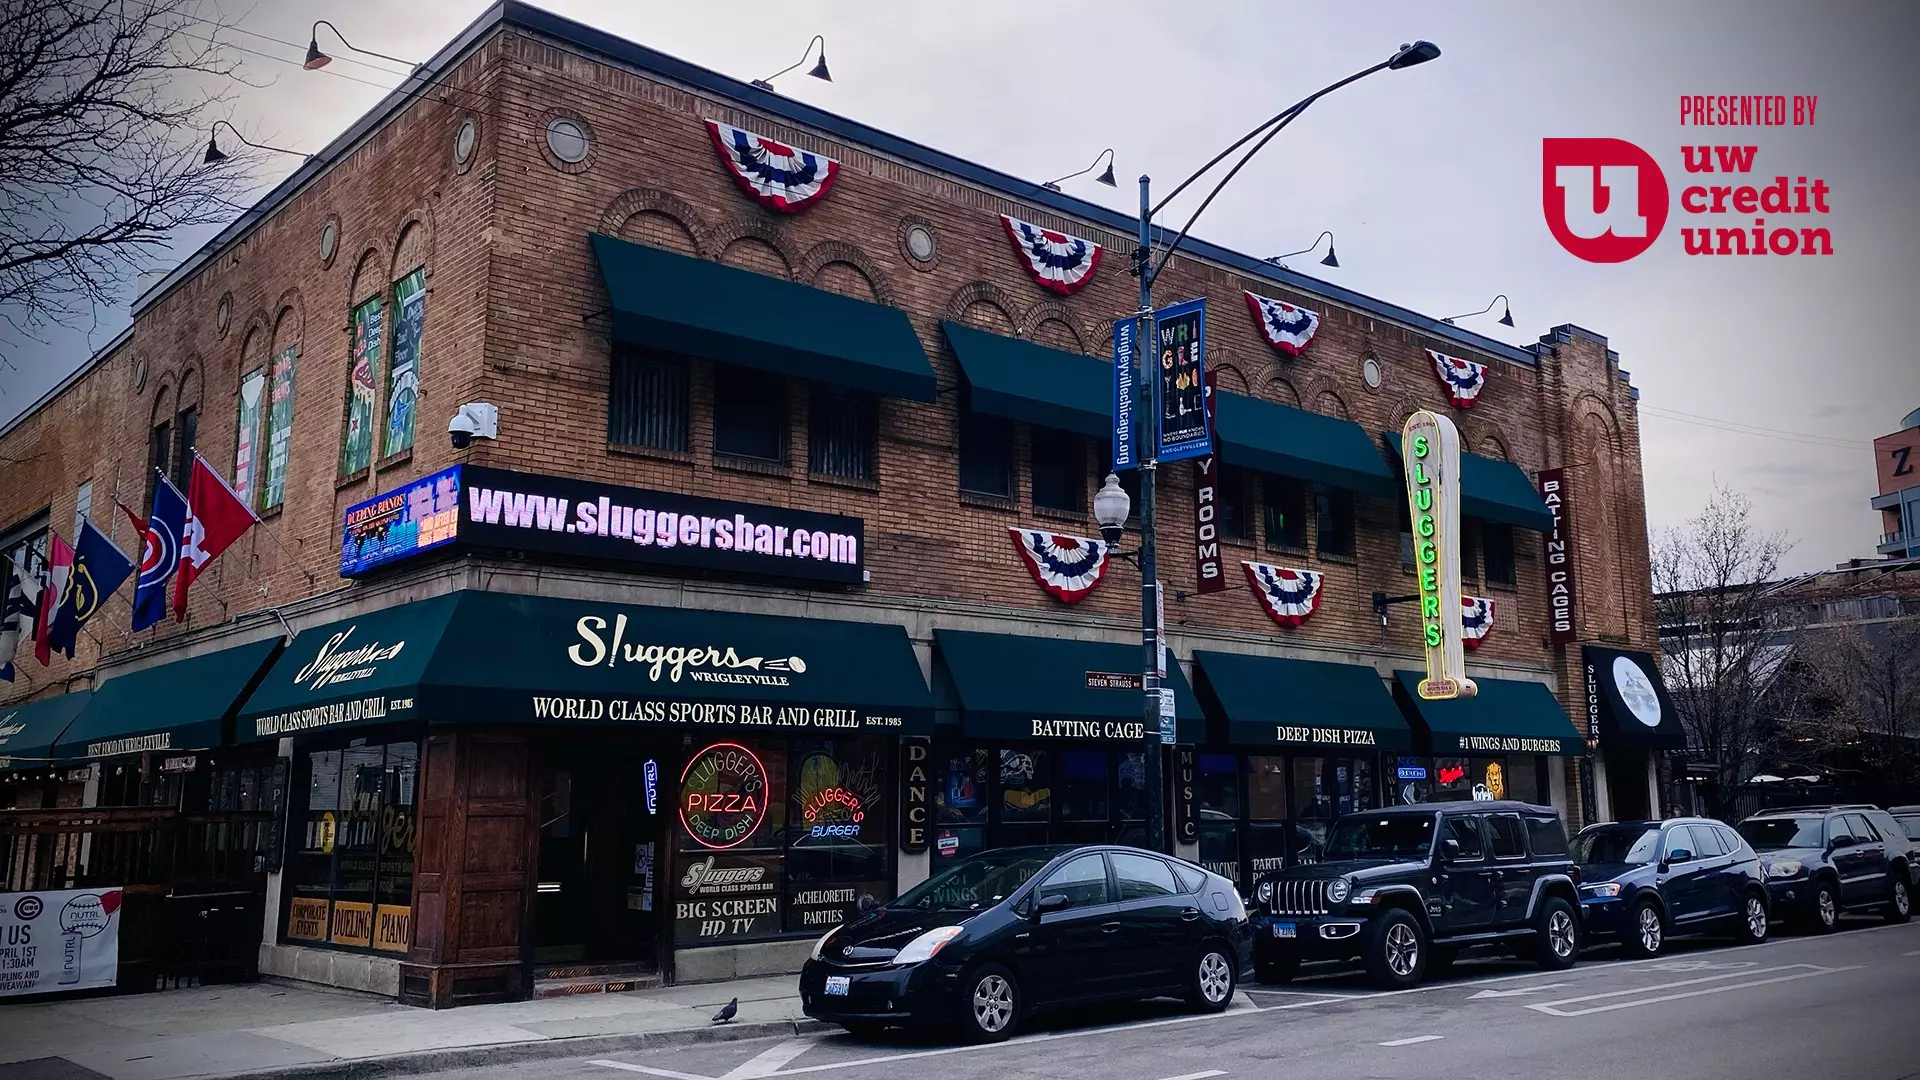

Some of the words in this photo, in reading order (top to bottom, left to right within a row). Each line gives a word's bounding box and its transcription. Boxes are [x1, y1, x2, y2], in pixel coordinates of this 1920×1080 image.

[1116, 324, 1132, 465] wrigleyvillechicago.org
[1892, 446, 1913, 477] Z
[468, 486, 857, 565] www.sluggersbar.com
[1198, 486, 1218, 579] ROOMS
[1543, 480, 1565, 564] BATTING
[1414, 434, 1440, 648] SLUGGERS
[1551, 571, 1571, 632] CAGES
[293, 625, 382, 691] Sluggers
[568, 613, 764, 683] Sluggers
[689, 671, 790, 687] WRIGLEYVILLE
[1088, 678, 1108, 687] STEVEN
[1109, 679, 1132, 688] STRAUSS
[256, 713, 280, 737] WORLD
[280, 711, 300, 733] CLASS
[300, 708, 328, 730] SPORTS
[329, 704, 344, 724] BAR
[344, 700, 361, 721] AND
[362, 696, 386, 719] GRILL
[533, 696, 604, 720] WORLD
[608, 699, 665, 722] CLASS
[668, 702, 736, 724] SPORTS
[740, 705, 773, 725] BAR
[776, 706, 810, 726] AND
[813, 708, 860, 728] GRILL
[866, 716, 884, 726] EST.
[884, 717, 902, 727] 1985
[1031, 719, 1101, 738] BATTING
[1105, 721, 1144, 739] CAGE
[1276, 726, 1310, 742] DEEP
[1312, 728, 1341, 743] DISH
[1343, 729, 1375, 745] PIZZA
[1459, 736, 1469, 749] #1
[1470, 736, 1500, 750] WINGS
[1501, 737, 1519, 751] AND
[1520, 739, 1560, 752] BURGERS
[687, 751, 763, 792] SLUGGER'S
[687, 793, 757, 812] PIZZA
[804, 787, 864, 823] SLUGGER'S
[909, 745, 927, 844] DANCE
[1180, 751, 1195, 836] MUSIC
[689, 813, 720, 839] DEEP
[724, 813, 754, 840] DISH
[811, 824, 860, 838] BURGER
[681, 855, 765, 895] Sluggers
[1252, 856, 1284, 871] PARTY
[700, 886, 719, 894] WORLD
[721, 884, 739, 893] CLASS
[739, 883, 761, 892] SPORTS
[933, 886, 978, 902] WINGS
[292, 904, 327, 920] CORPORATE
[676, 901, 706, 919] BIG
[712, 898, 777, 917] SCREEN
[804, 909, 843, 925] PARTIES
[8, 924, 31, 946] US
[296, 920, 319, 937] EVENTS
[334, 908, 371, 940] DUELING
[700, 920, 726, 938] HD
[731, 917, 756, 934] TV
[22, 946, 38, 957] 1ST
[24, 970, 39, 980] AND
